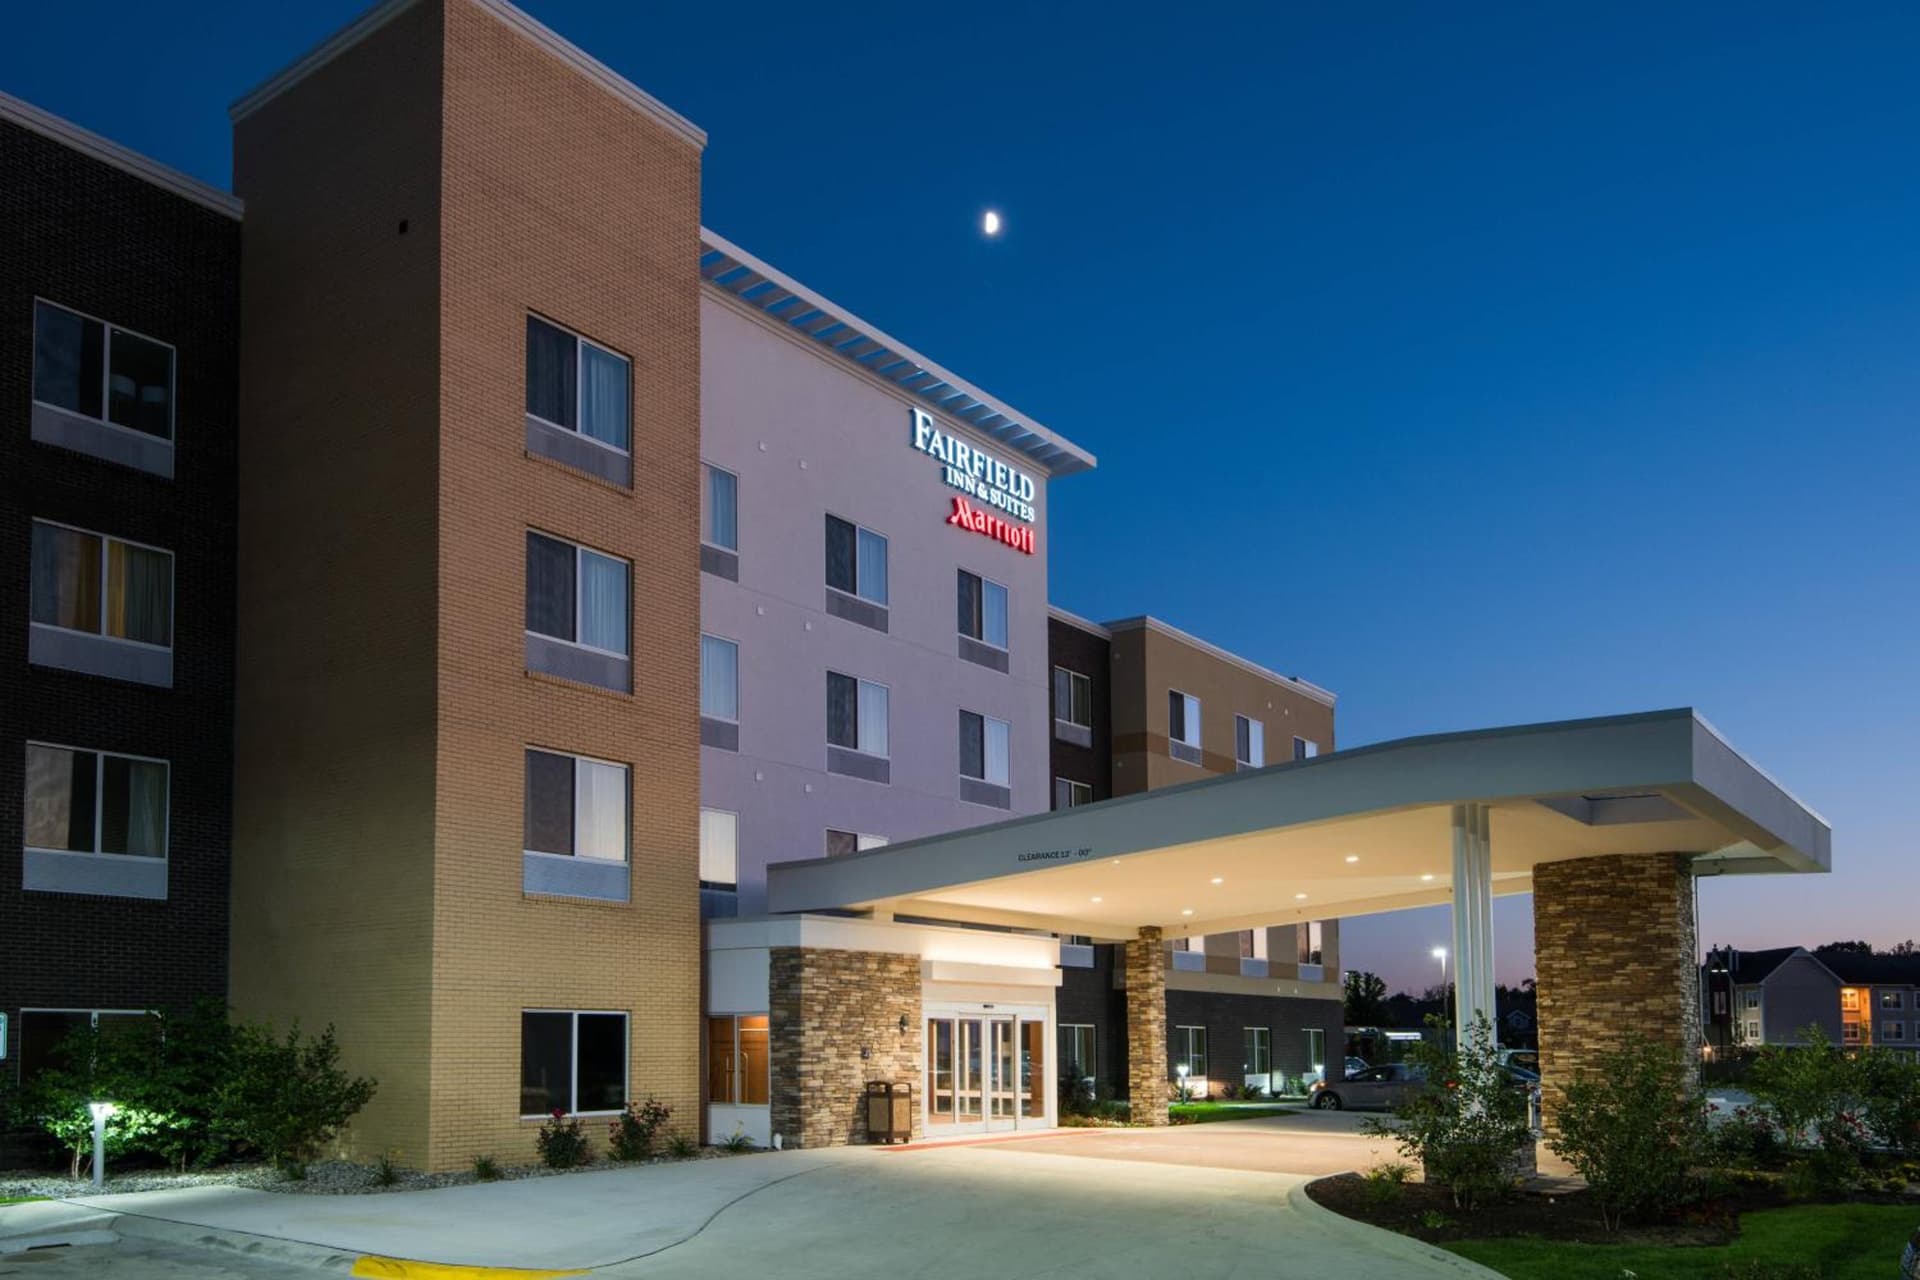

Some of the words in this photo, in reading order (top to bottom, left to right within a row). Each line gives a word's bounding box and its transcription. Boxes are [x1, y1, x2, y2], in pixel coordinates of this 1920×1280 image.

[912, 407, 1035, 502] FAIRFIELD
[945, 466, 976, 493] INN
[976, 483, 989, 501] &
[989, 488, 1035, 523] SUITES
[949, 496, 1035, 554] Marriott
[1017, 850, 1060, 861] CLEARANCE
